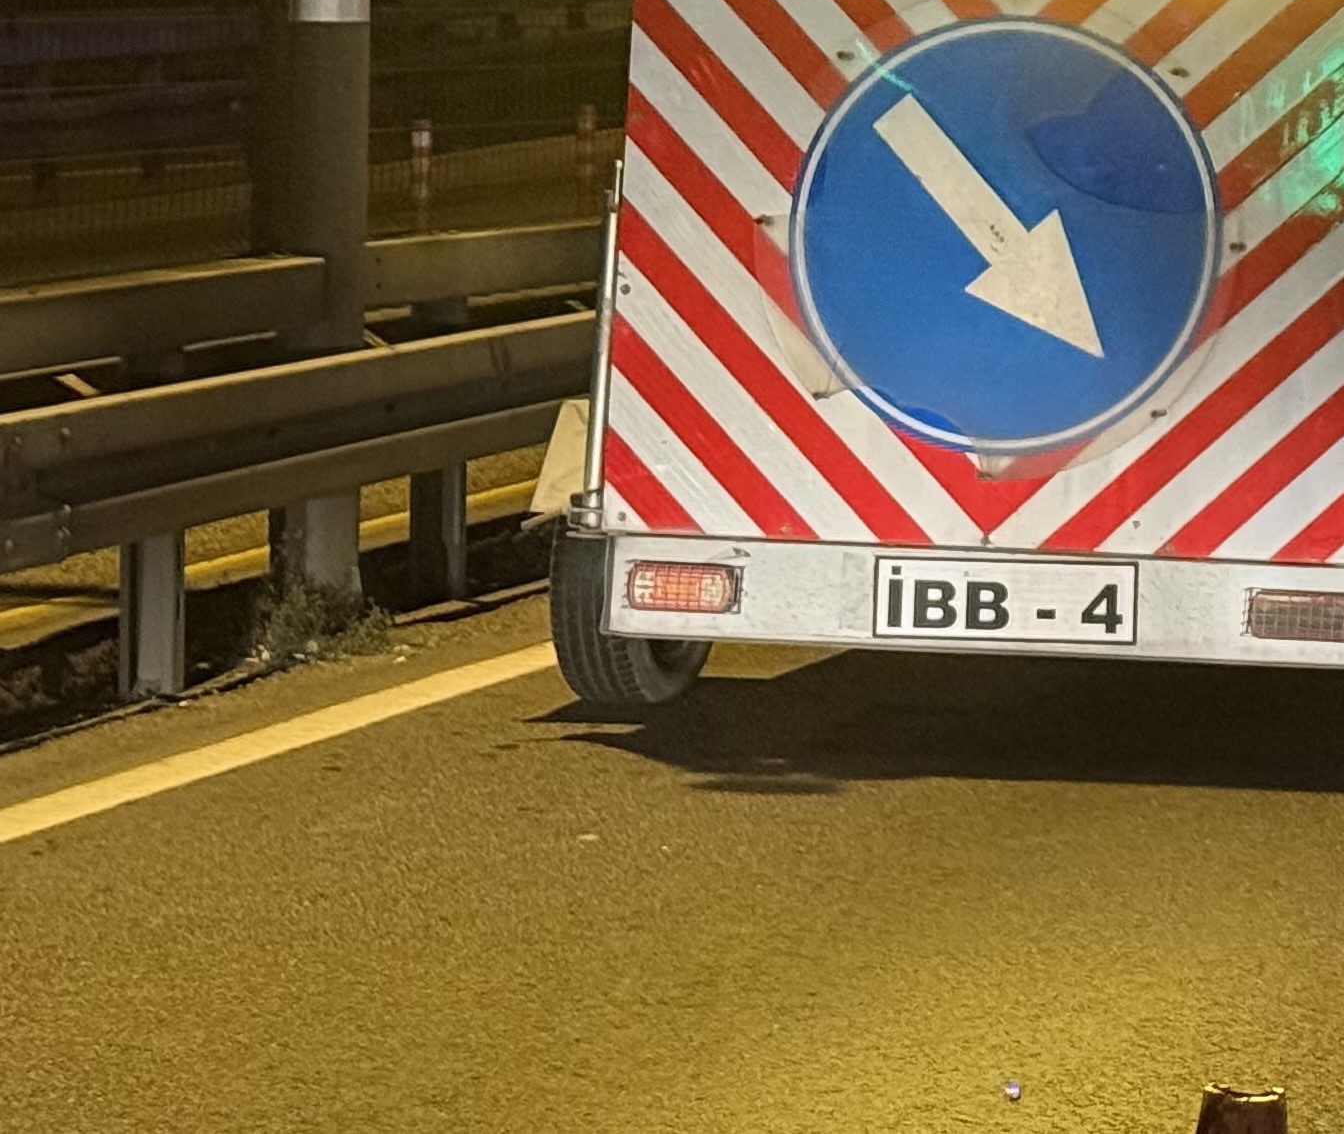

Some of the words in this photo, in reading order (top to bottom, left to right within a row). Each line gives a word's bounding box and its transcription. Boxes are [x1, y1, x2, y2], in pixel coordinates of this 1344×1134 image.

[886, 566, 1010, 631] İBB
[1036, 609, 1056, 621] -
[1081, 583, 1123, 634] 4
